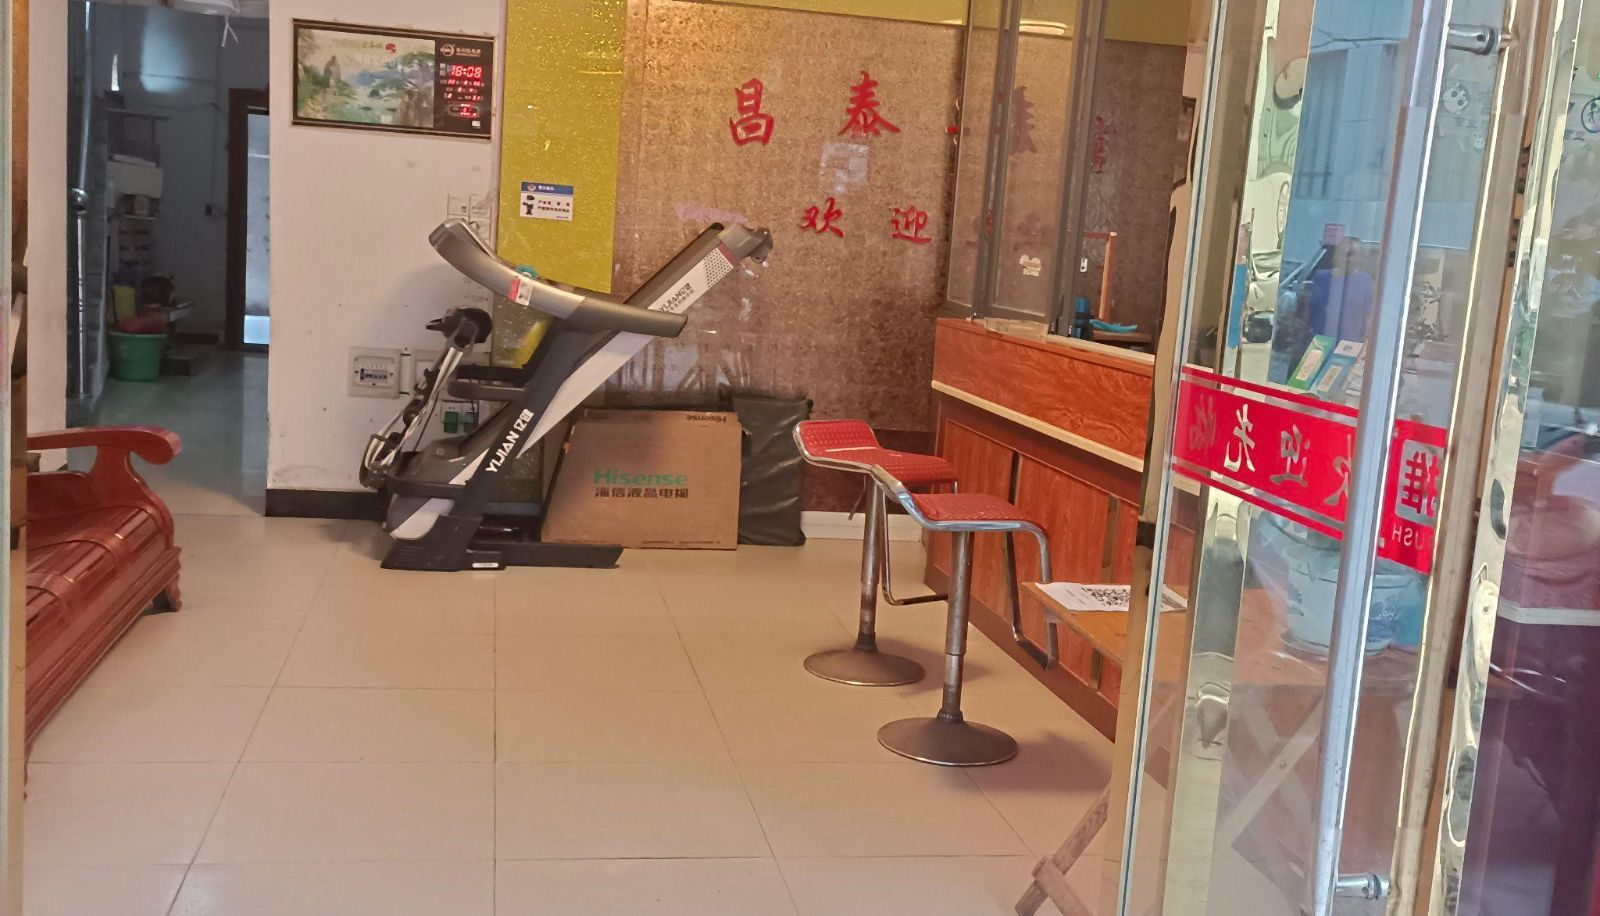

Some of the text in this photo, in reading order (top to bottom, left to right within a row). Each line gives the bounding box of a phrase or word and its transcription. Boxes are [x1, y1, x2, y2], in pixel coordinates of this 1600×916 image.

[451, 65, 482, 79] 18:08
[485, 430, 520, 473] YIJIAN
[593, 468, 689, 486] Hisense
